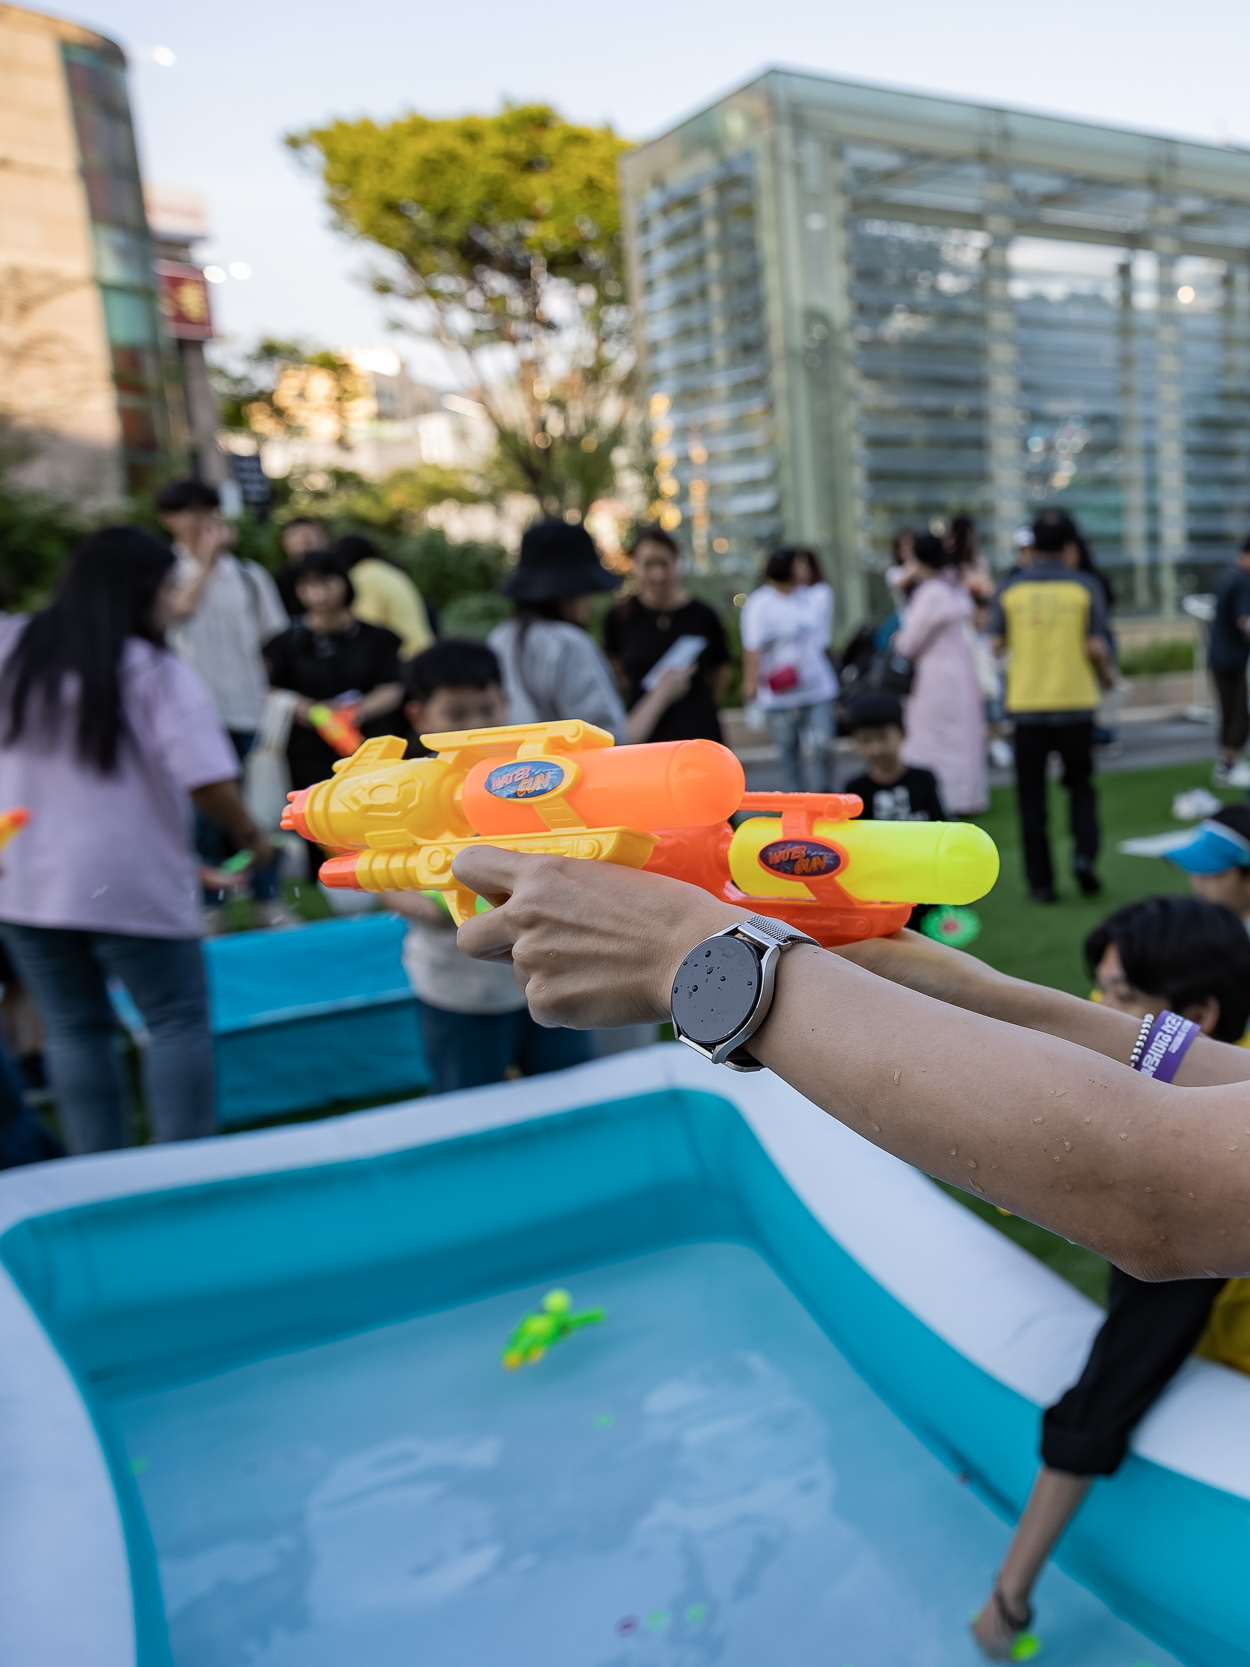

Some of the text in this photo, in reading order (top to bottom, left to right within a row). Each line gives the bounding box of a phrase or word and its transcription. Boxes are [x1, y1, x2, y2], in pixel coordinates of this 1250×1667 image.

[492, 765, 531, 791] WATER
[517, 770, 550, 797] GUN
[769, 845, 807, 865] WATER
[794, 854, 826, 875] GUN
